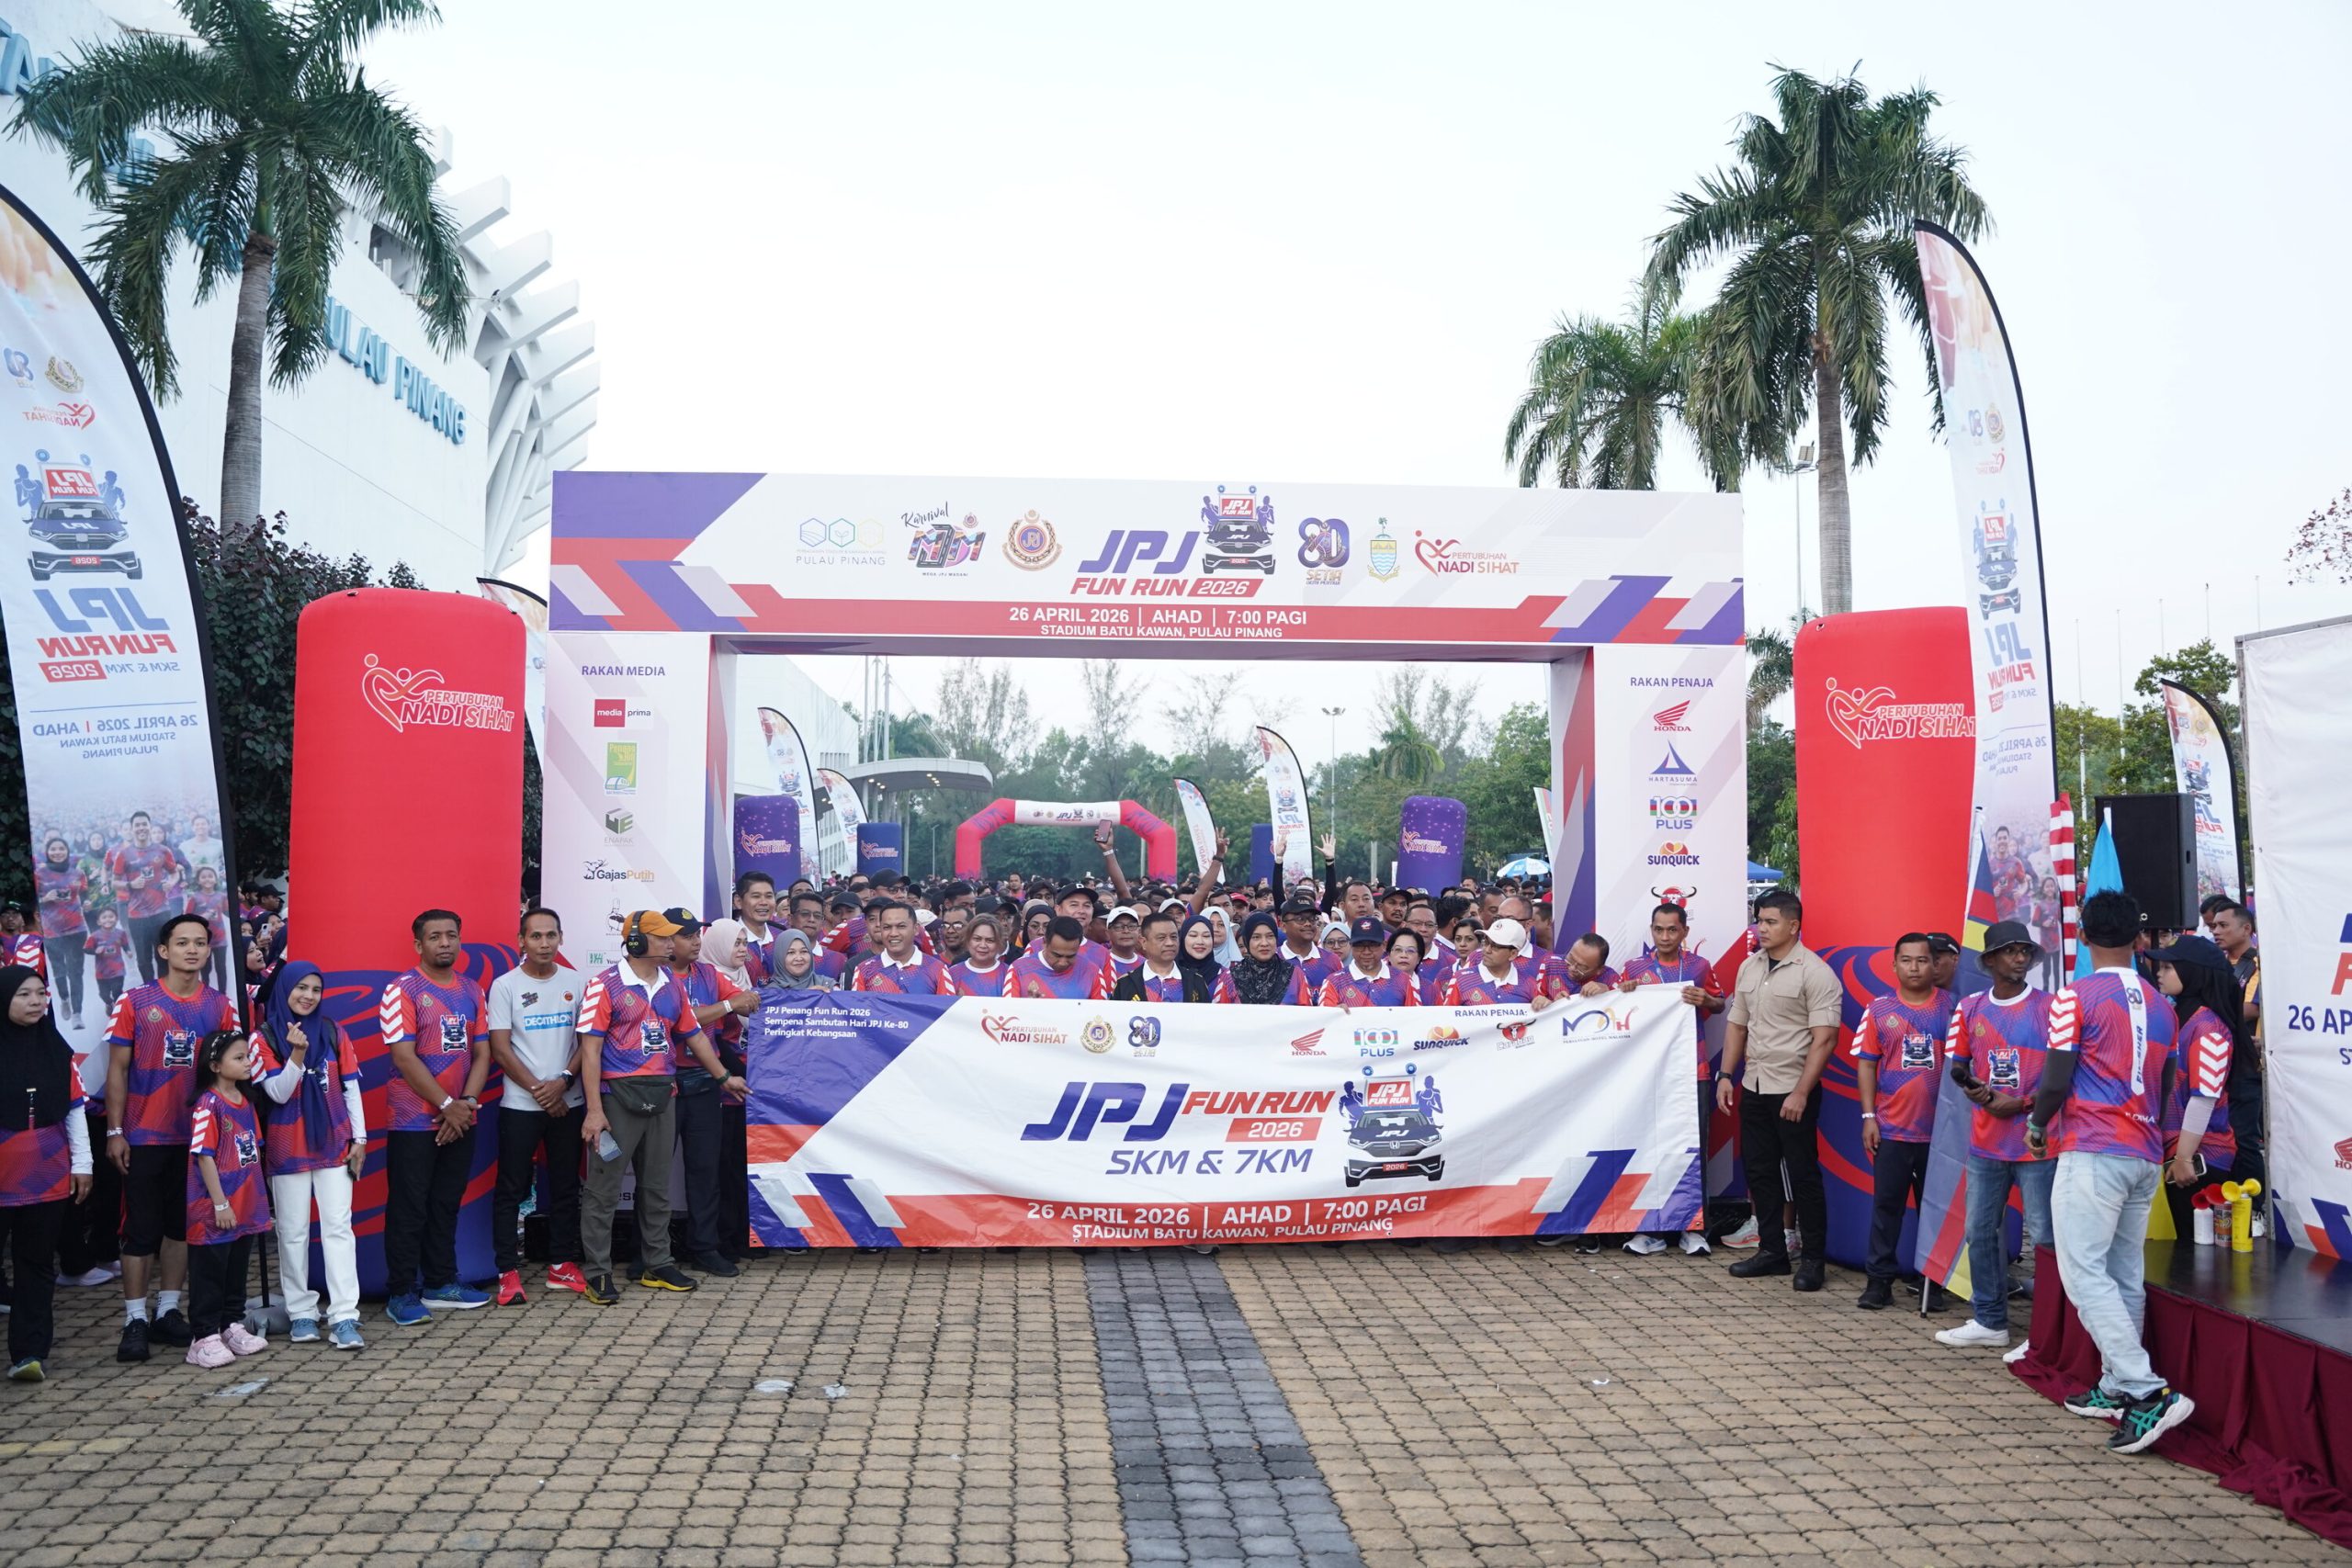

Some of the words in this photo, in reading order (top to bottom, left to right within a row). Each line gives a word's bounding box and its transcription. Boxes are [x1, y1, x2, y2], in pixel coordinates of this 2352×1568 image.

[323, 296, 390, 385] ULAU
[395, 355, 467, 446] PINANG
[1225, 500, 1250, 511] JPJ
[900, 501, 949, 528] Karnival
[1297, 517, 1350, 569] 80
[1078, 530, 1200, 574] JPJ
[1452, 552, 1507, 560] PERTUBUHAN
[796, 556, 836, 565] PULAU
[841, 556, 886, 566] PINANG
[1438, 561, 1474, 573] NADI
[1477, 561, 1520, 574] SIHAT
[1070, 578, 1127, 594] FUN
[1130, 579, 1189, 595] RUN
[1197, 581, 1250, 595] 2026
[1009, 607, 1029, 621] 26
[1033, 607, 1086, 622] APRIL
[1091, 608, 1129, 623] 2026
[1152, 610, 1202, 624] AHAD
[1227, 610, 1261, 624] 7:00
[1266, 610, 1306, 625] PAGI
[1041, 625, 1096, 637] STADIUM
[1100, 626, 1134, 637] BATU
[1136, 626, 1186, 638] KAWAN,
[1189, 627, 1232, 637] PULAU
[1235, 627, 1283, 638] PINANG
[582, 666, 623, 676] RAKAN
[627, 666, 666, 676] MEDIA
[1631, 677, 1669, 687] RAKAN
[1671, 677, 1713, 688] PENAJA
[424, 690, 503, 709] PERTUBUHAN
[401, 701, 462, 726] NADI
[464, 706, 514, 731] SIHAT
[628, 709, 651, 717] prima
[1879, 704, 1964, 718] PERTUBUHAN
[1858, 718, 1915, 739] NADI
[1653, 796, 1693, 818] 100
[1656, 819, 1693, 829] PLUS
[765, 1006, 779, 1015] JPJ
[781, 1007, 811, 1017] Penang
[814, 1007, 830, 1016] Fun
[831, 1008, 848, 1016] Run
[850, 1008, 870, 1017] 2026
[1490, 1009, 1528, 1017] PENAJA:
[2288, 1004, 2315, 1032] 26
[765, 1017, 803, 1028] Sempena
[805, 1018, 847, 1027] Sambutan
[849, 1019, 866, 1028] Hari
[868, 1019, 882, 1028] JPJ
[884, 1020, 909, 1029] Ke-80
[764, 1028, 805, 1038] Peringkat
[807, 1029, 856, 1039] Kebangsaan
[1001, 1032, 1031, 1043] NADI
[1033, 1033, 1069, 1044] SIHAT
[1356, 1028, 1393, 1047] 100
[1361, 1048, 1395, 1057] PLUS
[1371, 1083, 1406, 1098] JPJ
[1020, 1081, 1190, 1142] JPJ
[1182, 1090, 1257, 1114] FUN
[1257, 1090, 1336, 1114] RUN
[1248, 1122, 1303, 1138] 2026
[1105, 1150, 1191, 1175] 5KM
[1196, 1150, 1223, 1174] &
[1235, 1148, 1313, 1173] 7KM
[1027, 1202, 1055, 1220] 26
[1061, 1205, 1128, 1224] APRIL
[1136, 1207, 1190, 1224] 2026
[1222, 1206, 1292, 1224] AHAD
[1324, 1201, 1369, 1221] 7:00
[1374, 1196, 1428, 1217] PAGI
[1072, 1224, 1150, 1240] STADIUM
[1155, 1225, 1197, 1239] BATU
[1203, 1225, 1270, 1240] KAWAN,
[1274, 1223, 1329, 1237] PULAU
[1332, 1217, 1394, 1235] PINANG
